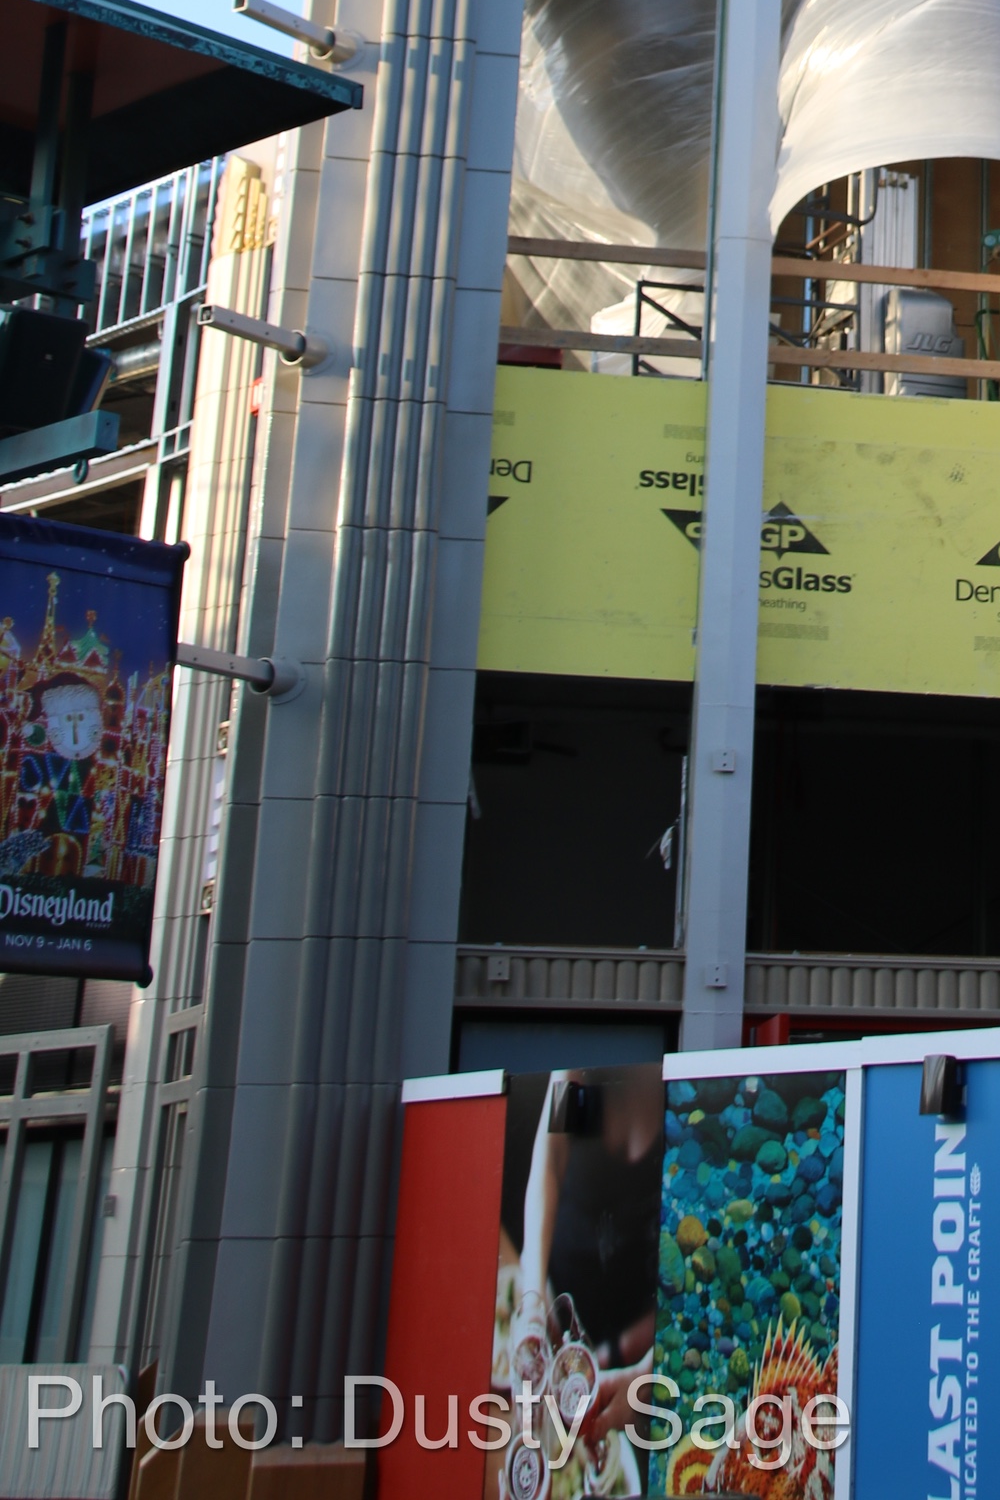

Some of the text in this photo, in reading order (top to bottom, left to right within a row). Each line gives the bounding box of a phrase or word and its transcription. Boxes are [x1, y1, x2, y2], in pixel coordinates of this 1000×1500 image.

[907, 332, 953, 353] JLG
[760, 523, 806, 549] GP
[0, 883, 115, 926] Disneyland
[5, 934, 34, 947] NOV
[36, 936, 45, 948] 9
[56, 938, 81, 950] JAN
[83, 939, 92, 951] 6
[931, 1122, 967, 1306] POIN
[967, 1198, 982, 1281] CRAFT
[967, 1290, 980, 1343] THE
[966, 1351, 979, 1388] TO
